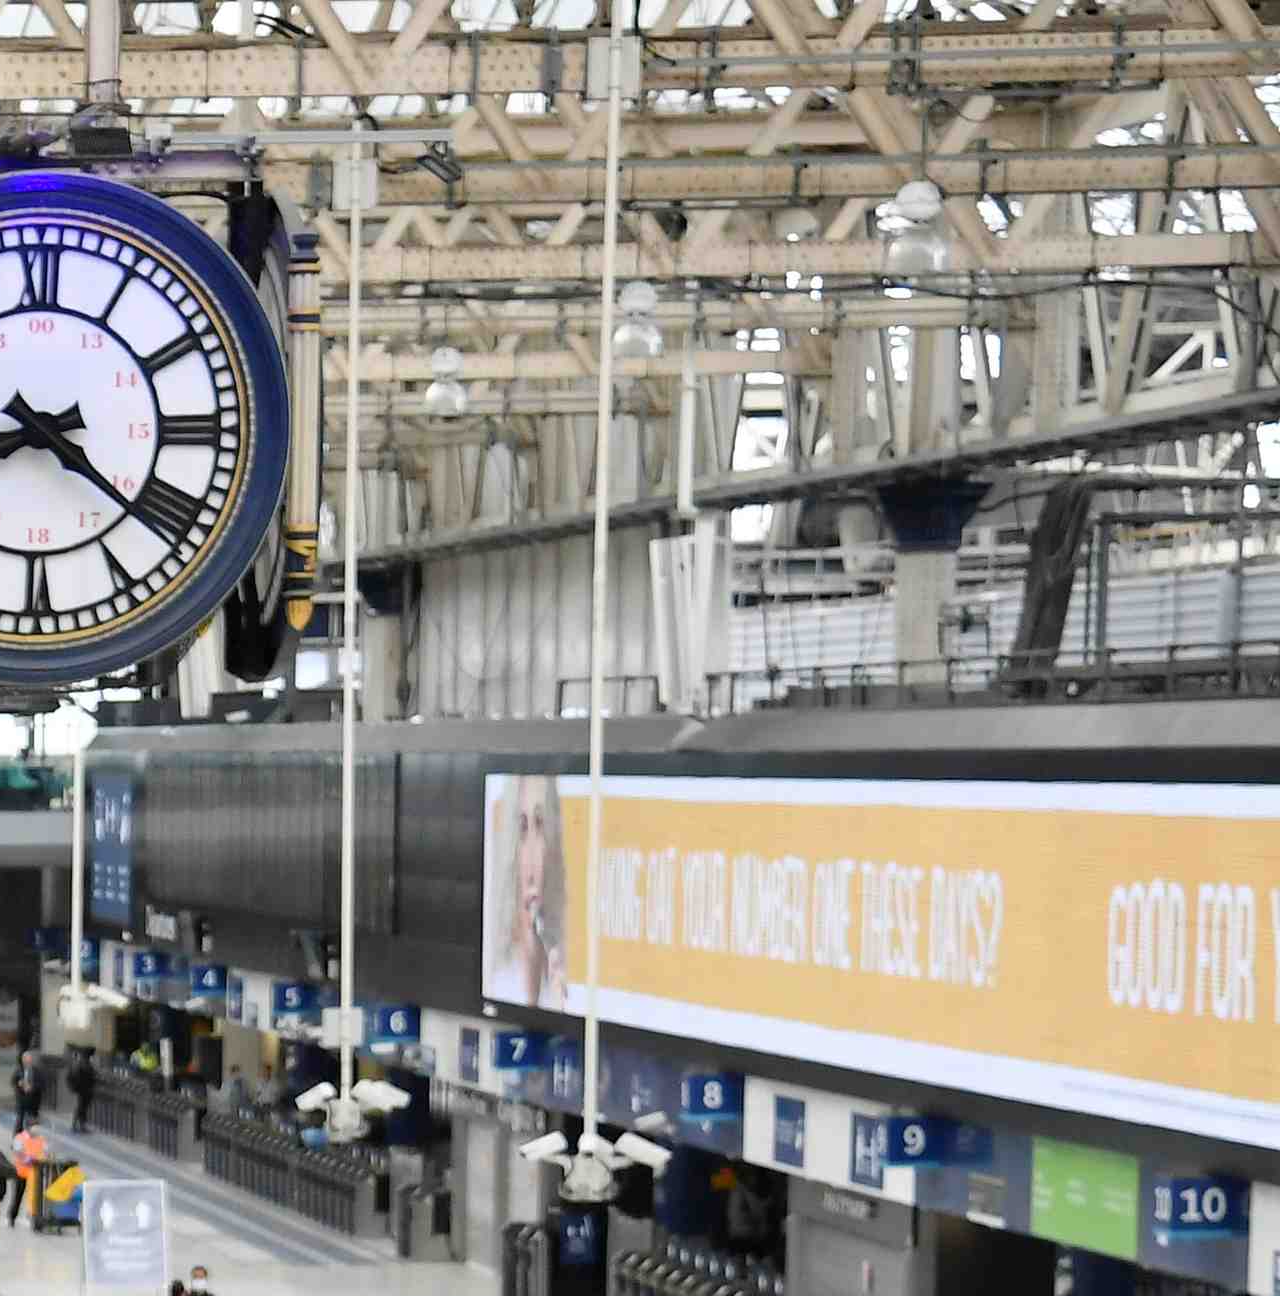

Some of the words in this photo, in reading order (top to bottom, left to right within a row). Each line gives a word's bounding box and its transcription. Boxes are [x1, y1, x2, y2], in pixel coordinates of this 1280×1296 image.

[17, 246, 61, 307] XII
[29, 319, 54, 333] 00
[81, 333, 103, 349] 13
[114, 371, 139, 388] 14
[128, 423, 150, 439] 15
[79, 511, 101, 528] 17
[28, 528, 50, 544] 18
[732, 853, 807, 962] NUMBER
[813, 857, 854, 969] ONE
[861, 861, 922, 977] THESE
[928, 865, 1005, 990] DAYS?
[1107, 878, 1186, 1014] GOOD
[1195, 881, 1256, 1024] FOR
[141, 955, 154, 973] 3
[202, 968, 219, 987] 4
[284, 986, 302, 1007] 5
[389, 1009, 407, 1035] 6
[510, 1037, 528, 1063] 7
[702, 1080, 724, 1110] 8
[902, 1124, 927, 1157] 9
[1179, 1186, 1228, 1223] 10
